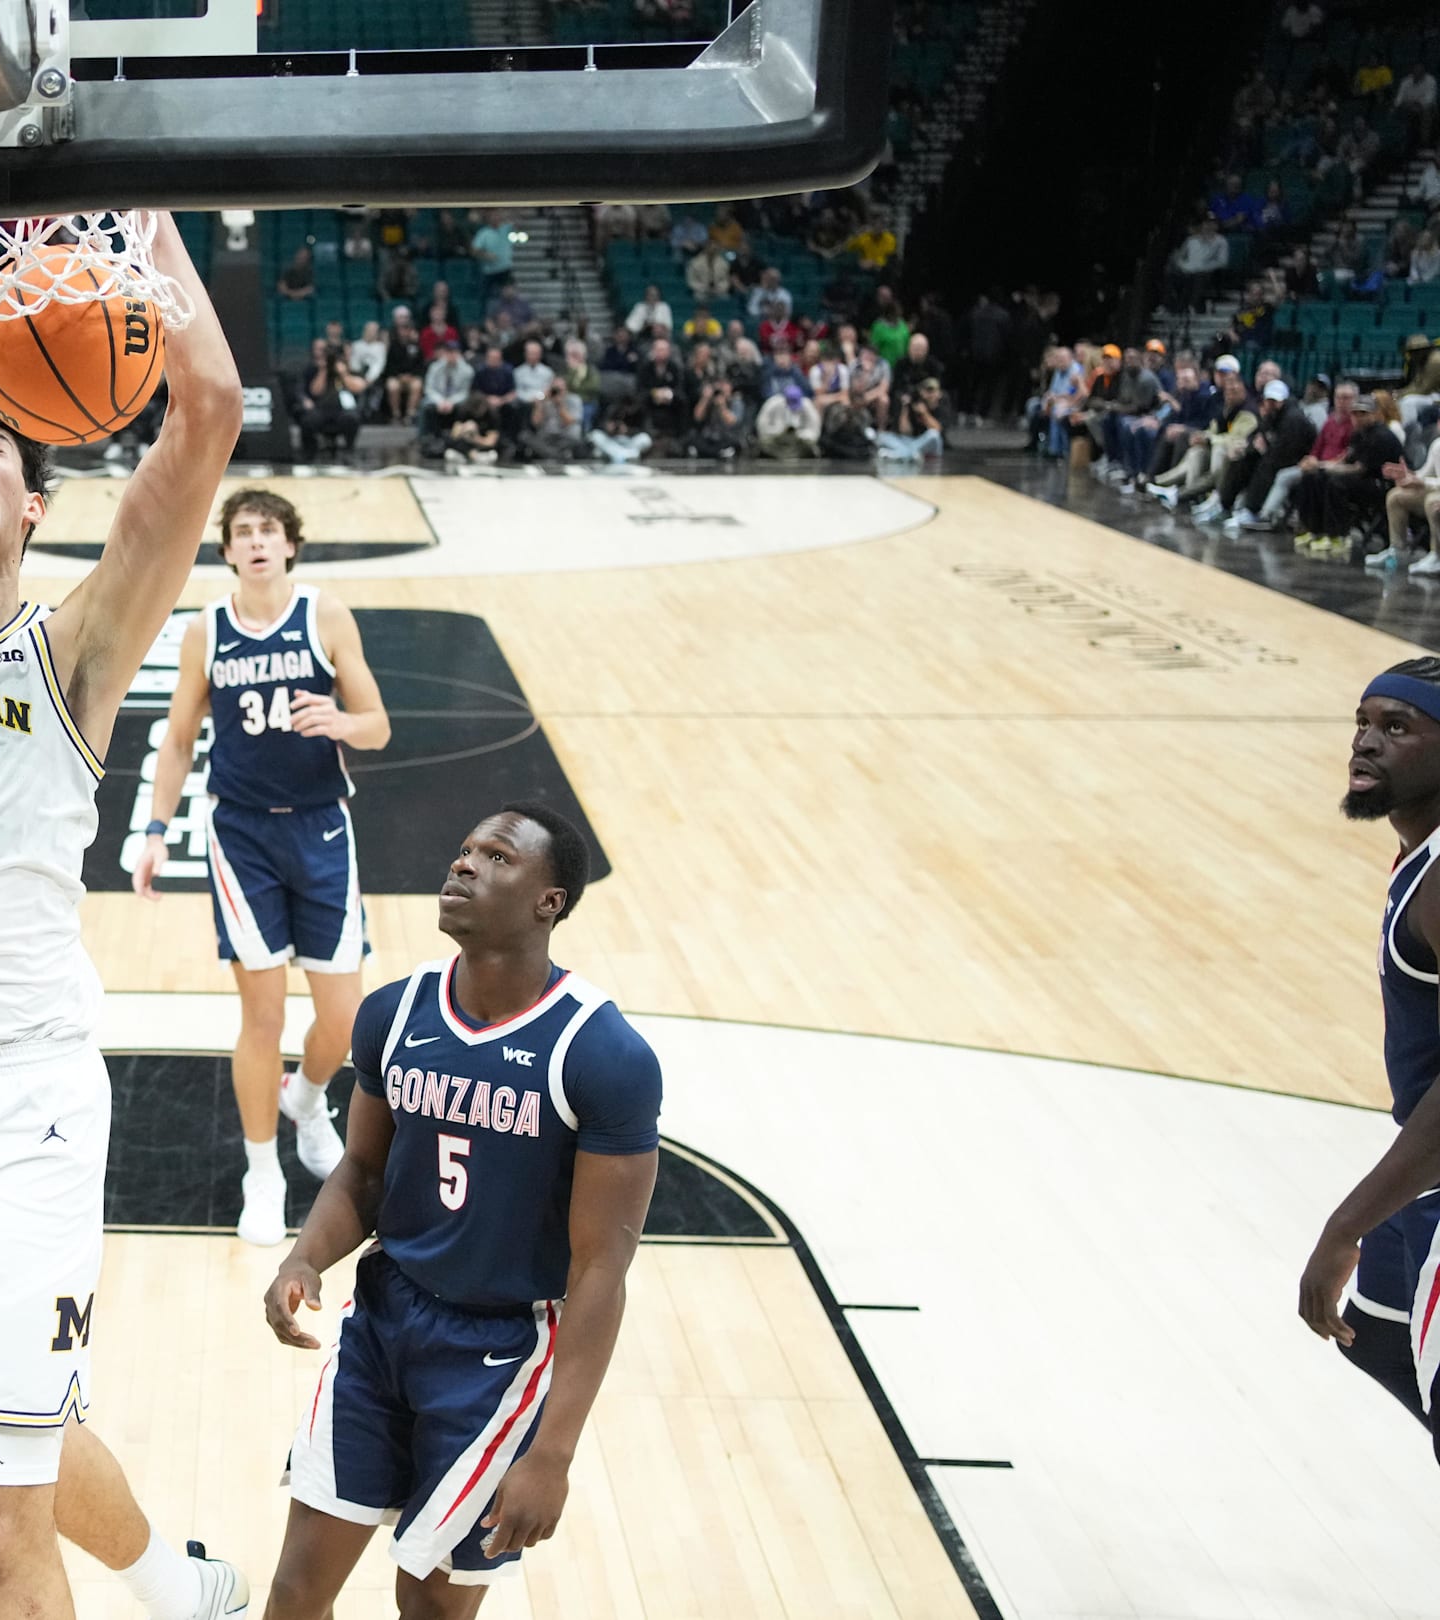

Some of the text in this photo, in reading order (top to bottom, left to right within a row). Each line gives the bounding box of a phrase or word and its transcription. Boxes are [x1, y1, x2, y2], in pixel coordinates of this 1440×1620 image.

[212, 649, 315, 689] GONZAGA
[238, 686, 293, 736] 34
[386, 1064, 541, 1138] GONZAGA
[437, 1132, 472, 1212] 5
[49, 1291, 95, 1353] M
